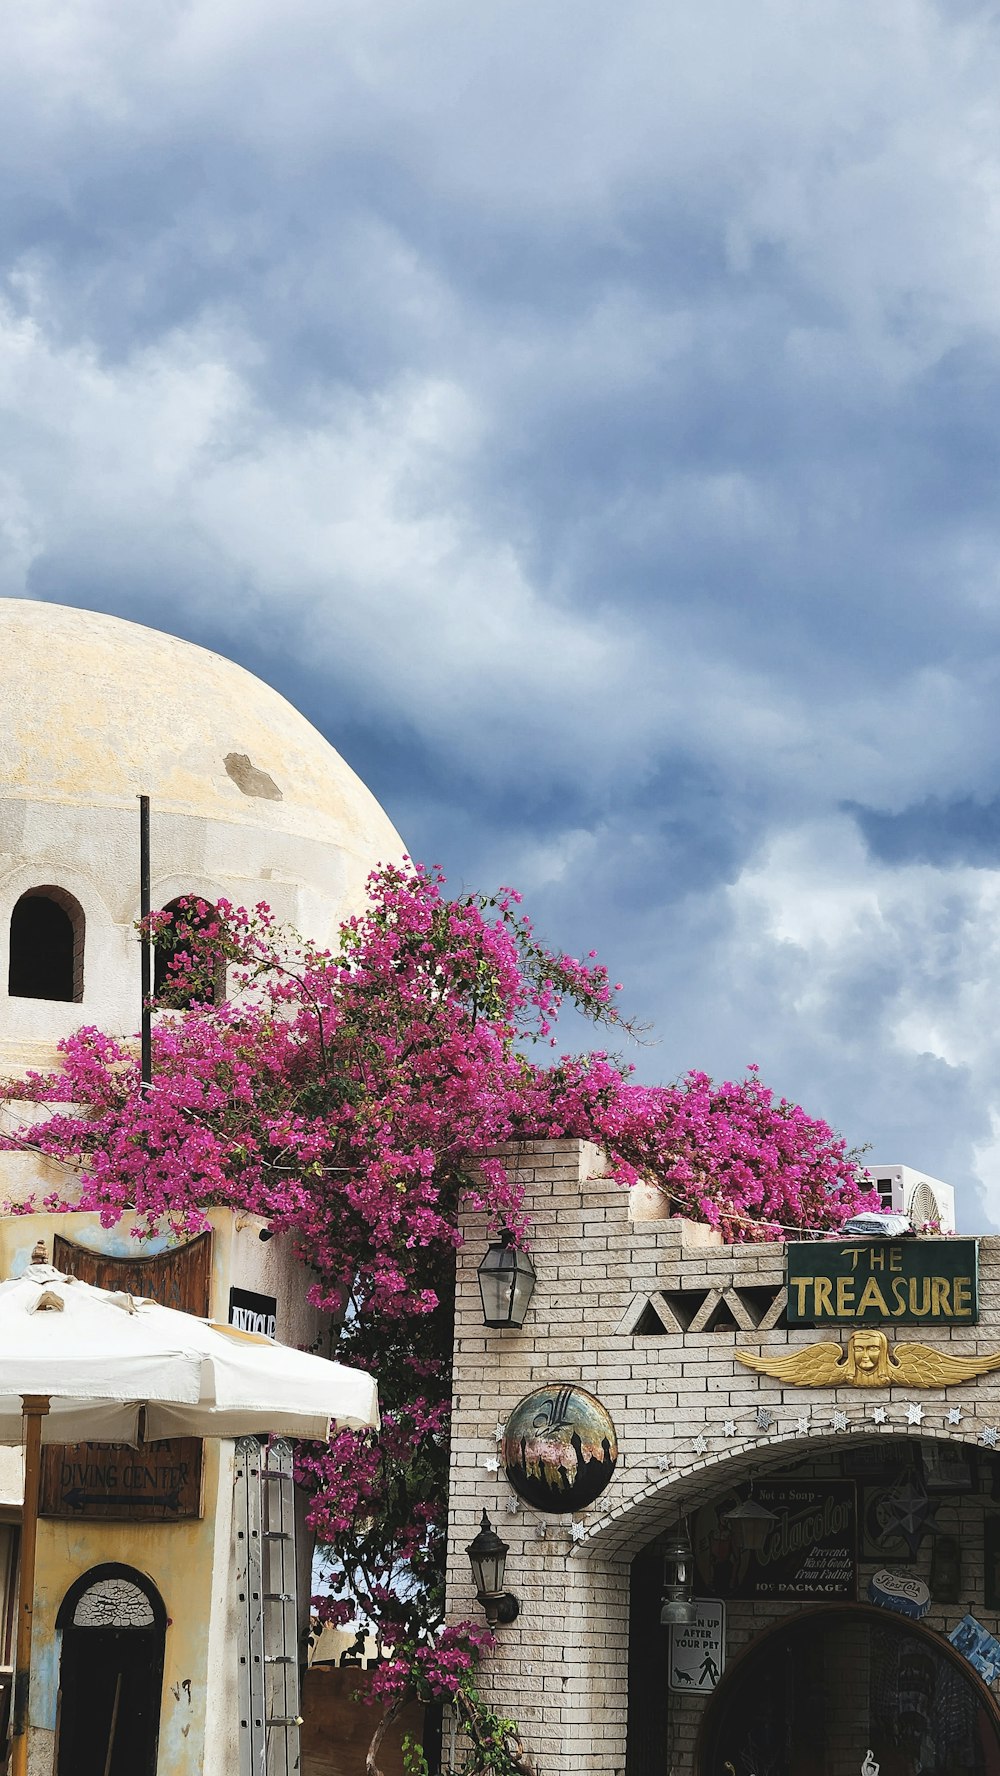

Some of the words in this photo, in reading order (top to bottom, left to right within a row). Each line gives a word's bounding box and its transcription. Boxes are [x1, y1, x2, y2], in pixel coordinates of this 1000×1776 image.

[840, 1248, 902, 1271] THE
[790, 1277, 971, 1316] TREASURE
[60, 1462, 117, 1488] DIVING
[123, 1462, 190, 1488] CENTER
[759, 1490, 775, 1499] Not
[789, 1490, 815, 1503] Soap
[809, 1546, 850, 1557] Prevents
[803, 1558, 826, 1568] Wash
[827, 1558, 854, 1568] Goods
[707, 1620, 720, 1628] UP
[683, 1629, 712, 1638] AFTER
[675, 1639, 700, 1649] YOUR
[703, 1641, 720, 1650] PET
